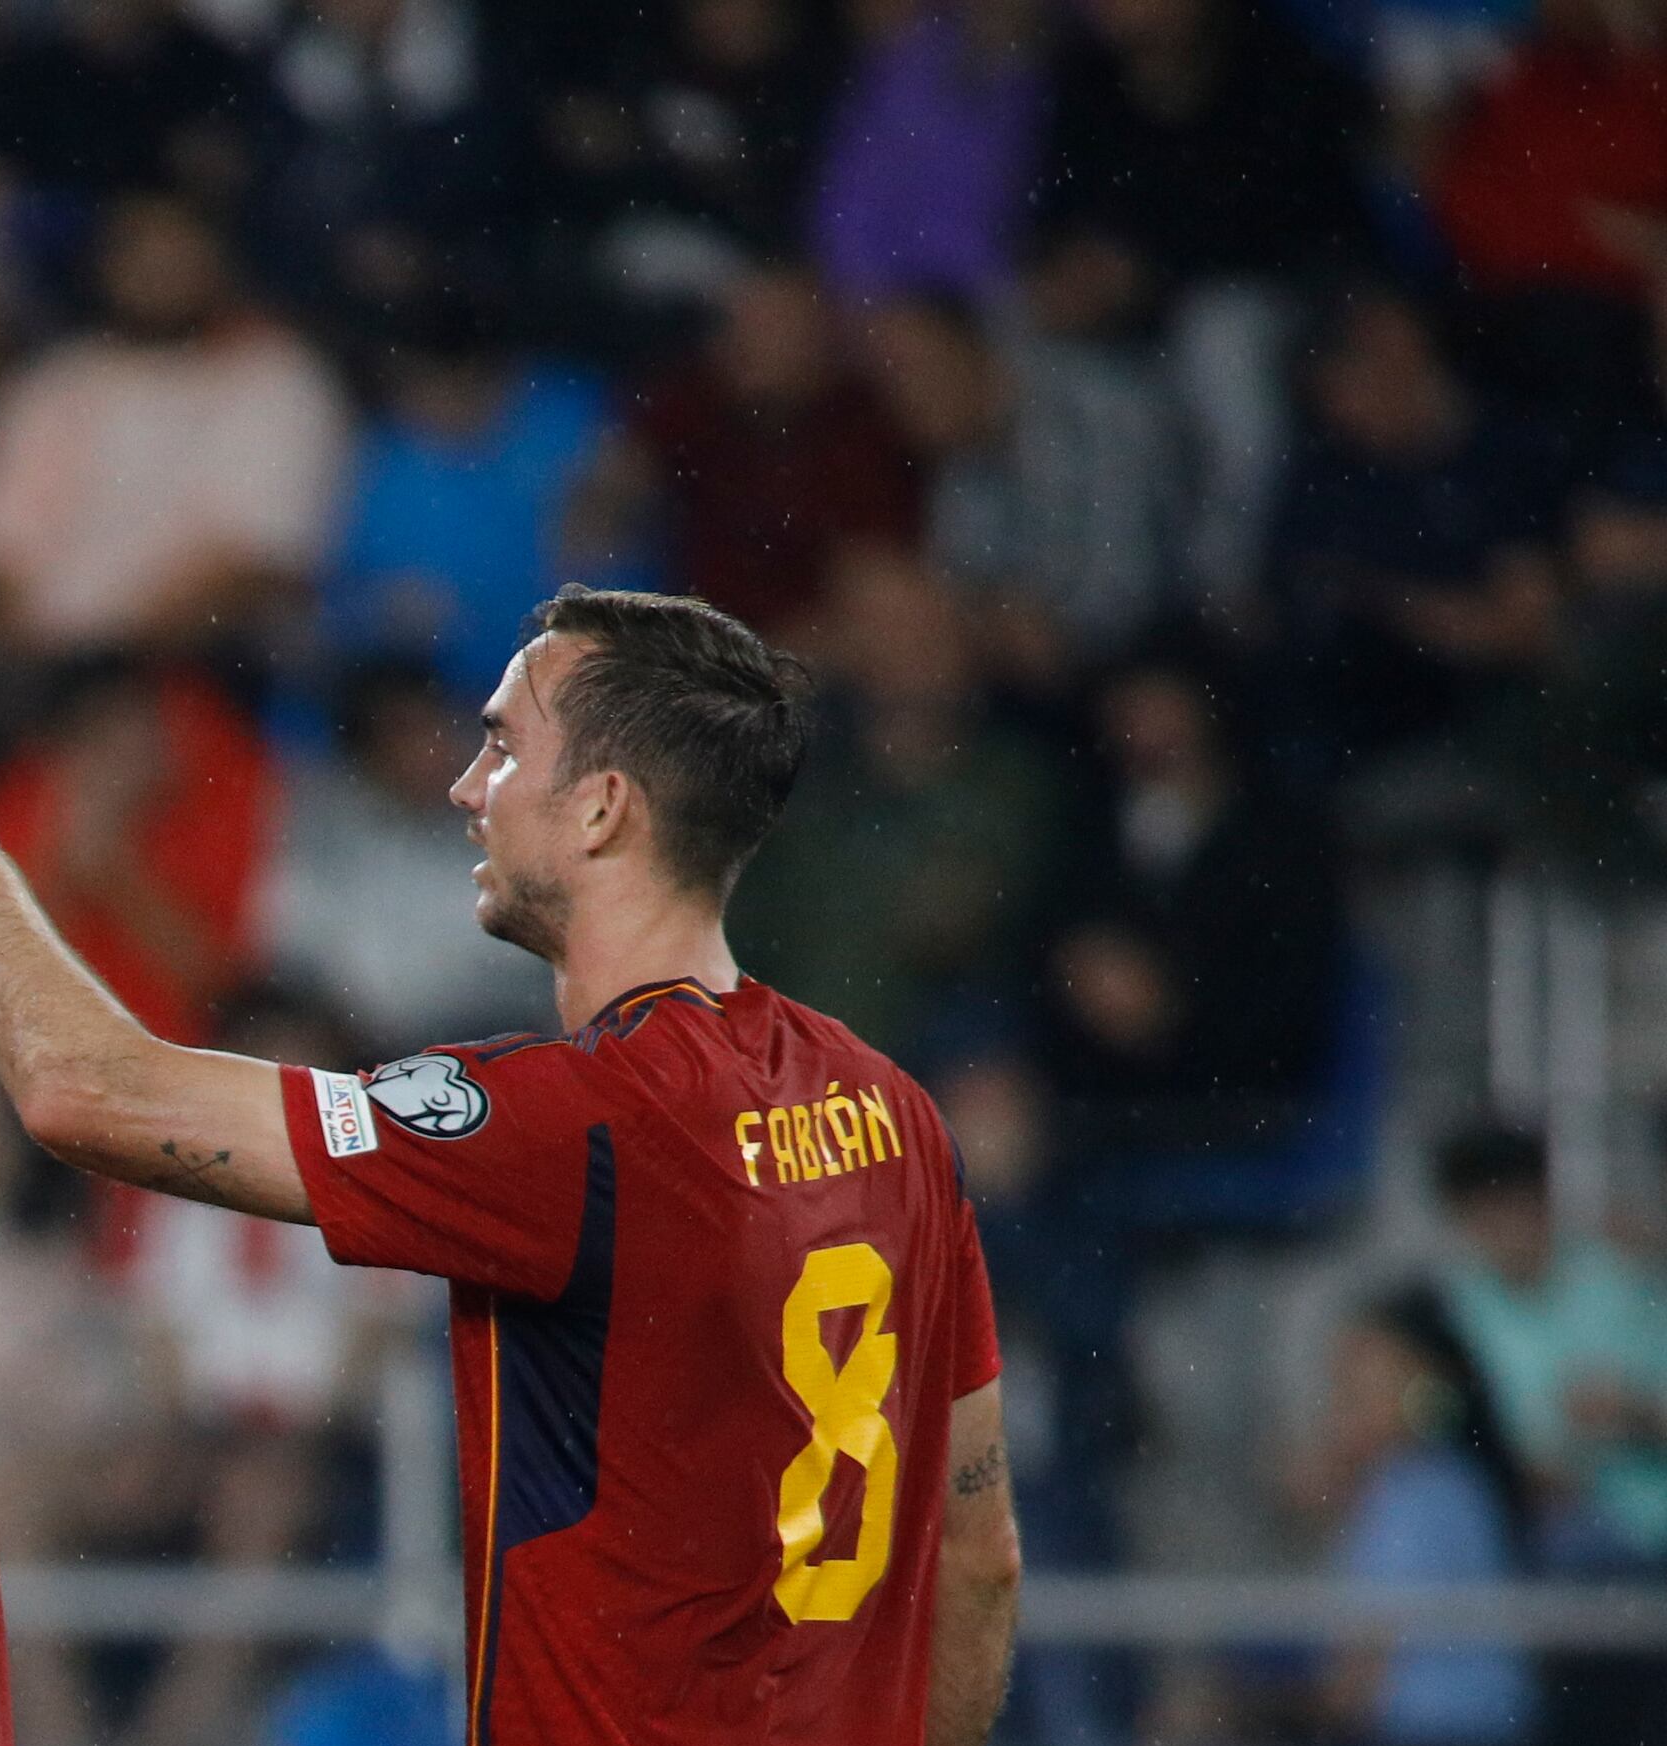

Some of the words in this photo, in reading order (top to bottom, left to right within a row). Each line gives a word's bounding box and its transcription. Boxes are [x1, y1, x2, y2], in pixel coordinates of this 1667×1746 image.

[331, 1079, 361, 1151] DATION
[735, 1081, 902, 1187] FABIÁN
[774, 1243, 898, 1625] 8
